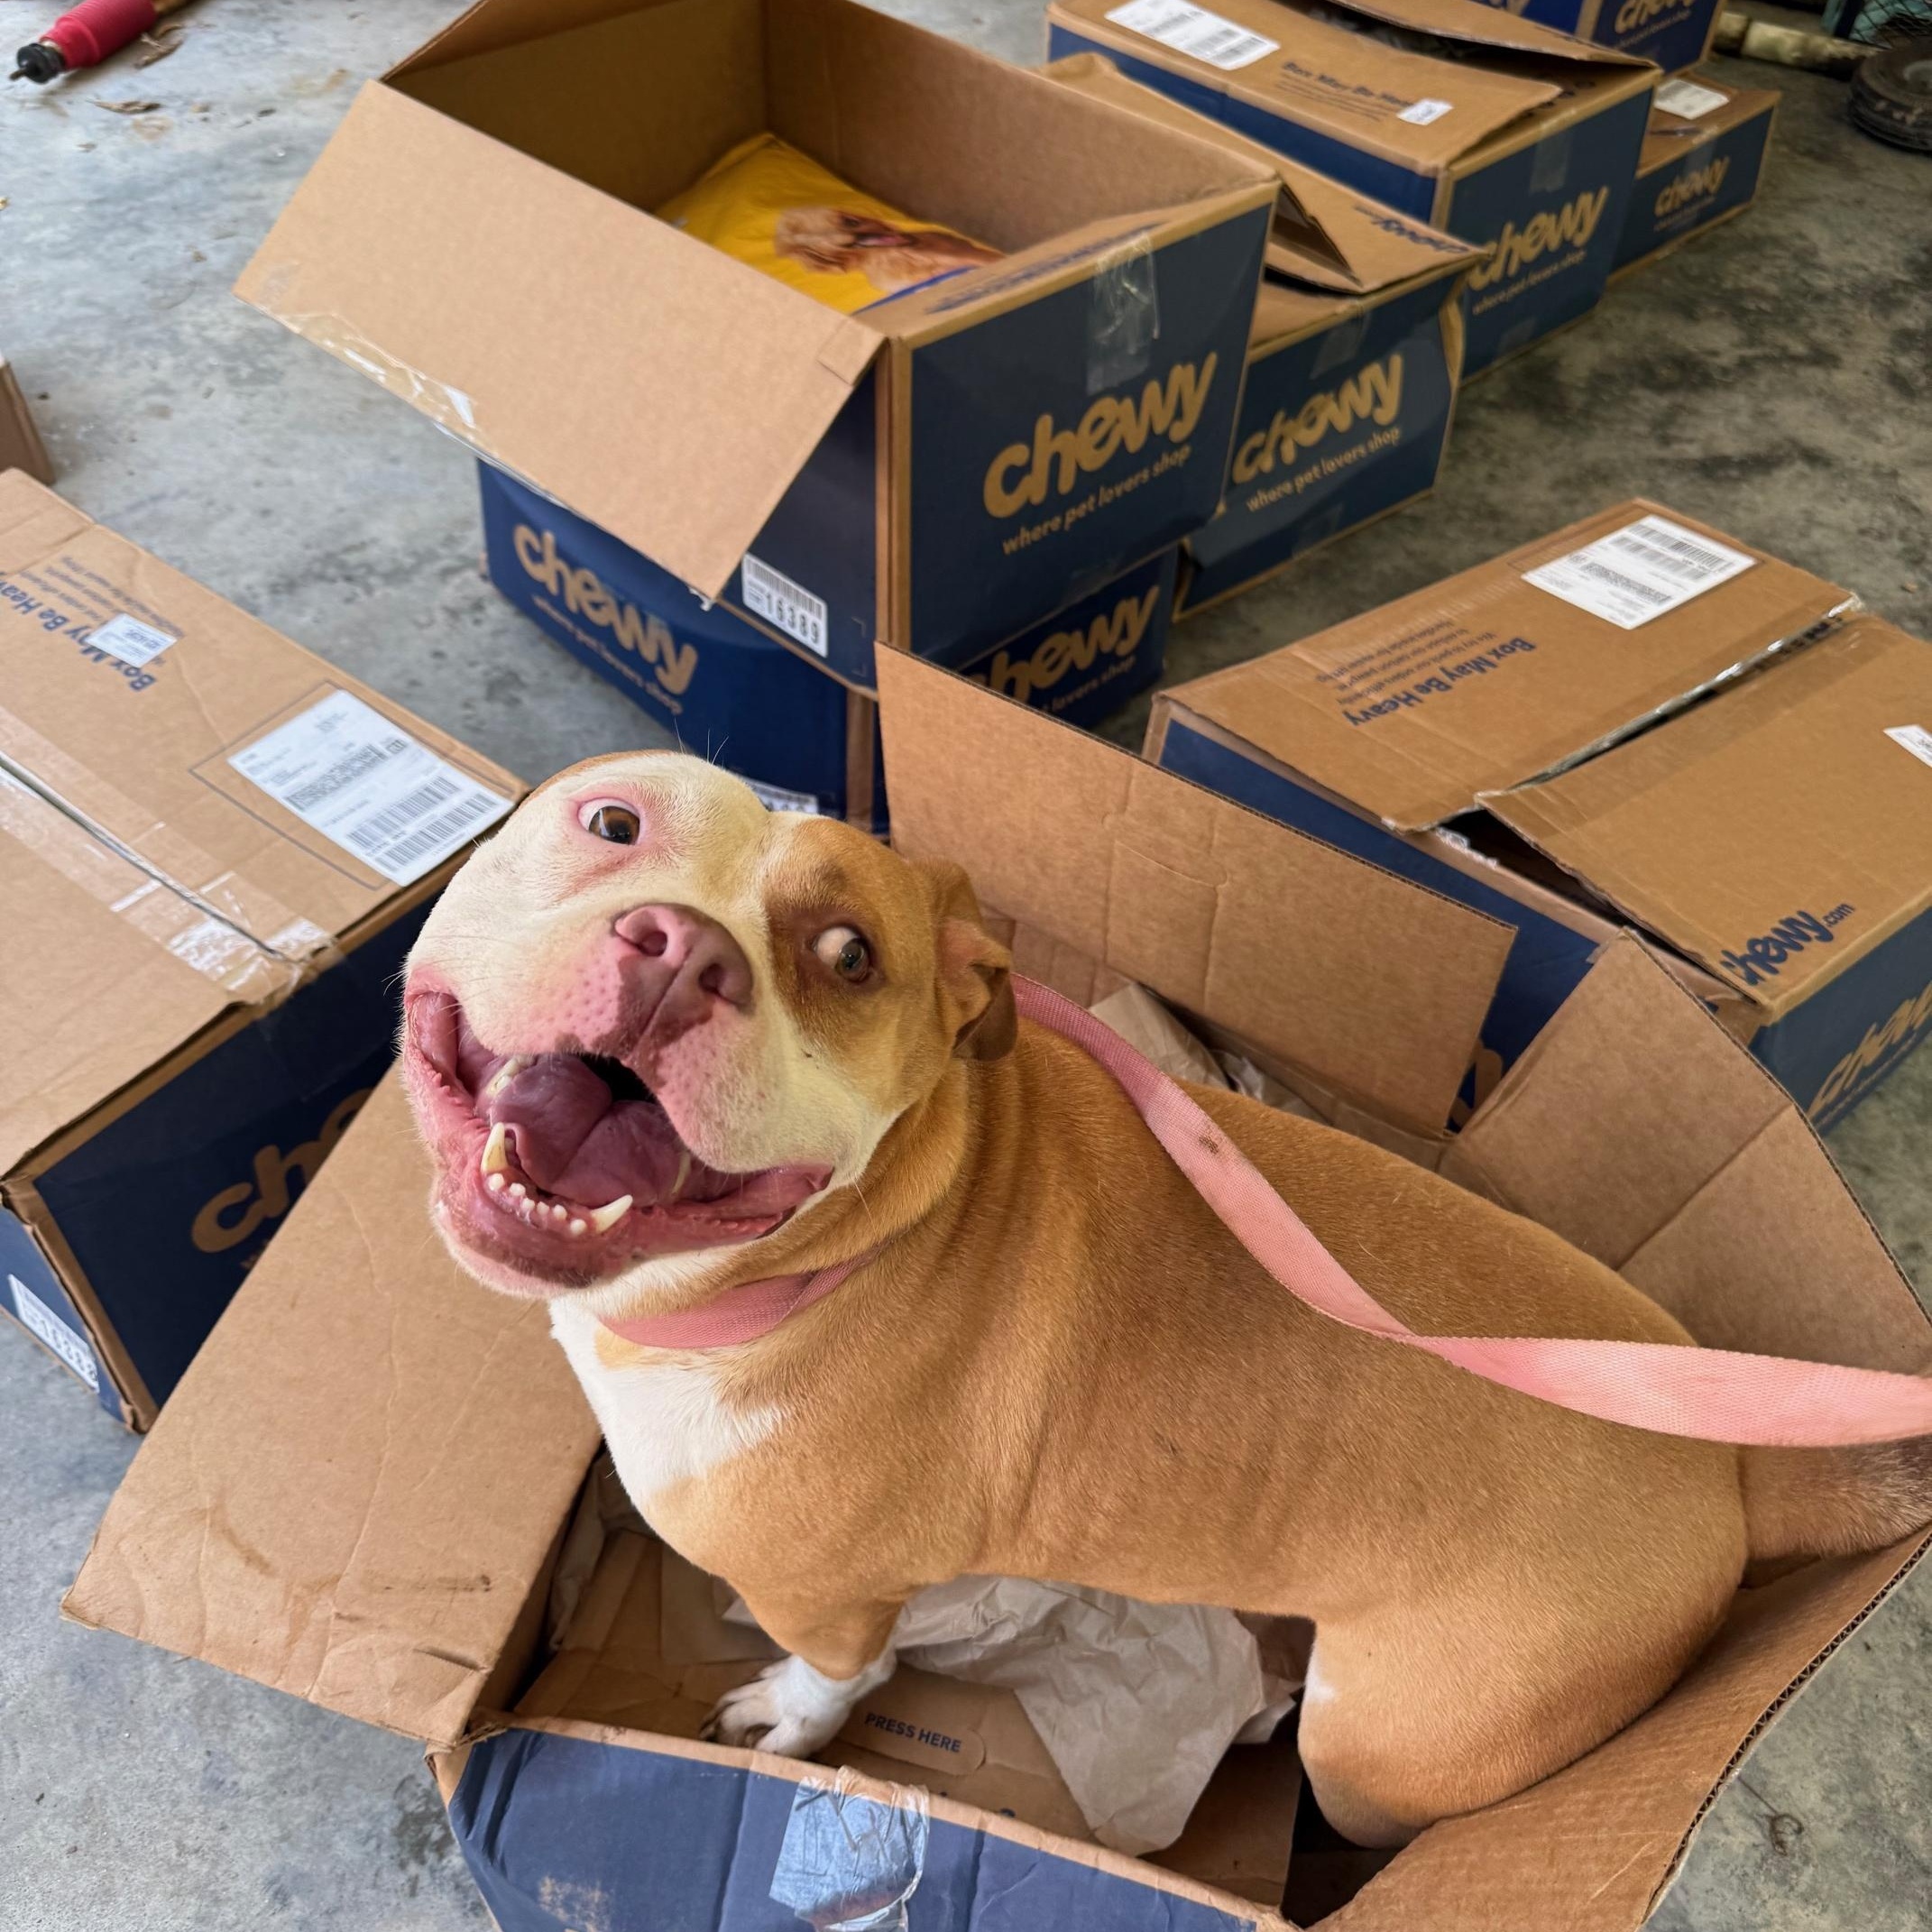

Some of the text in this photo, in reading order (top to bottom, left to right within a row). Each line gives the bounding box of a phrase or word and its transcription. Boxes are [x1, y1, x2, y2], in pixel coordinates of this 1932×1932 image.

[983, 352, 1218, 519] chewy
[1232, 354, 1403, 484] chewy
[1246, 427, 1403, 512] where pet lovers shop
[1002, 444, 1191, 556] where pet lovers shop
[38, 608, 69, 631] Be
[513, 522, 698, 695] chewy
[971, 585, 1160, 707] hewy
[1341, 637, 1537, 727] Box May Be Heavy
[864, 1712, 962, 1753] PRESS HERE
